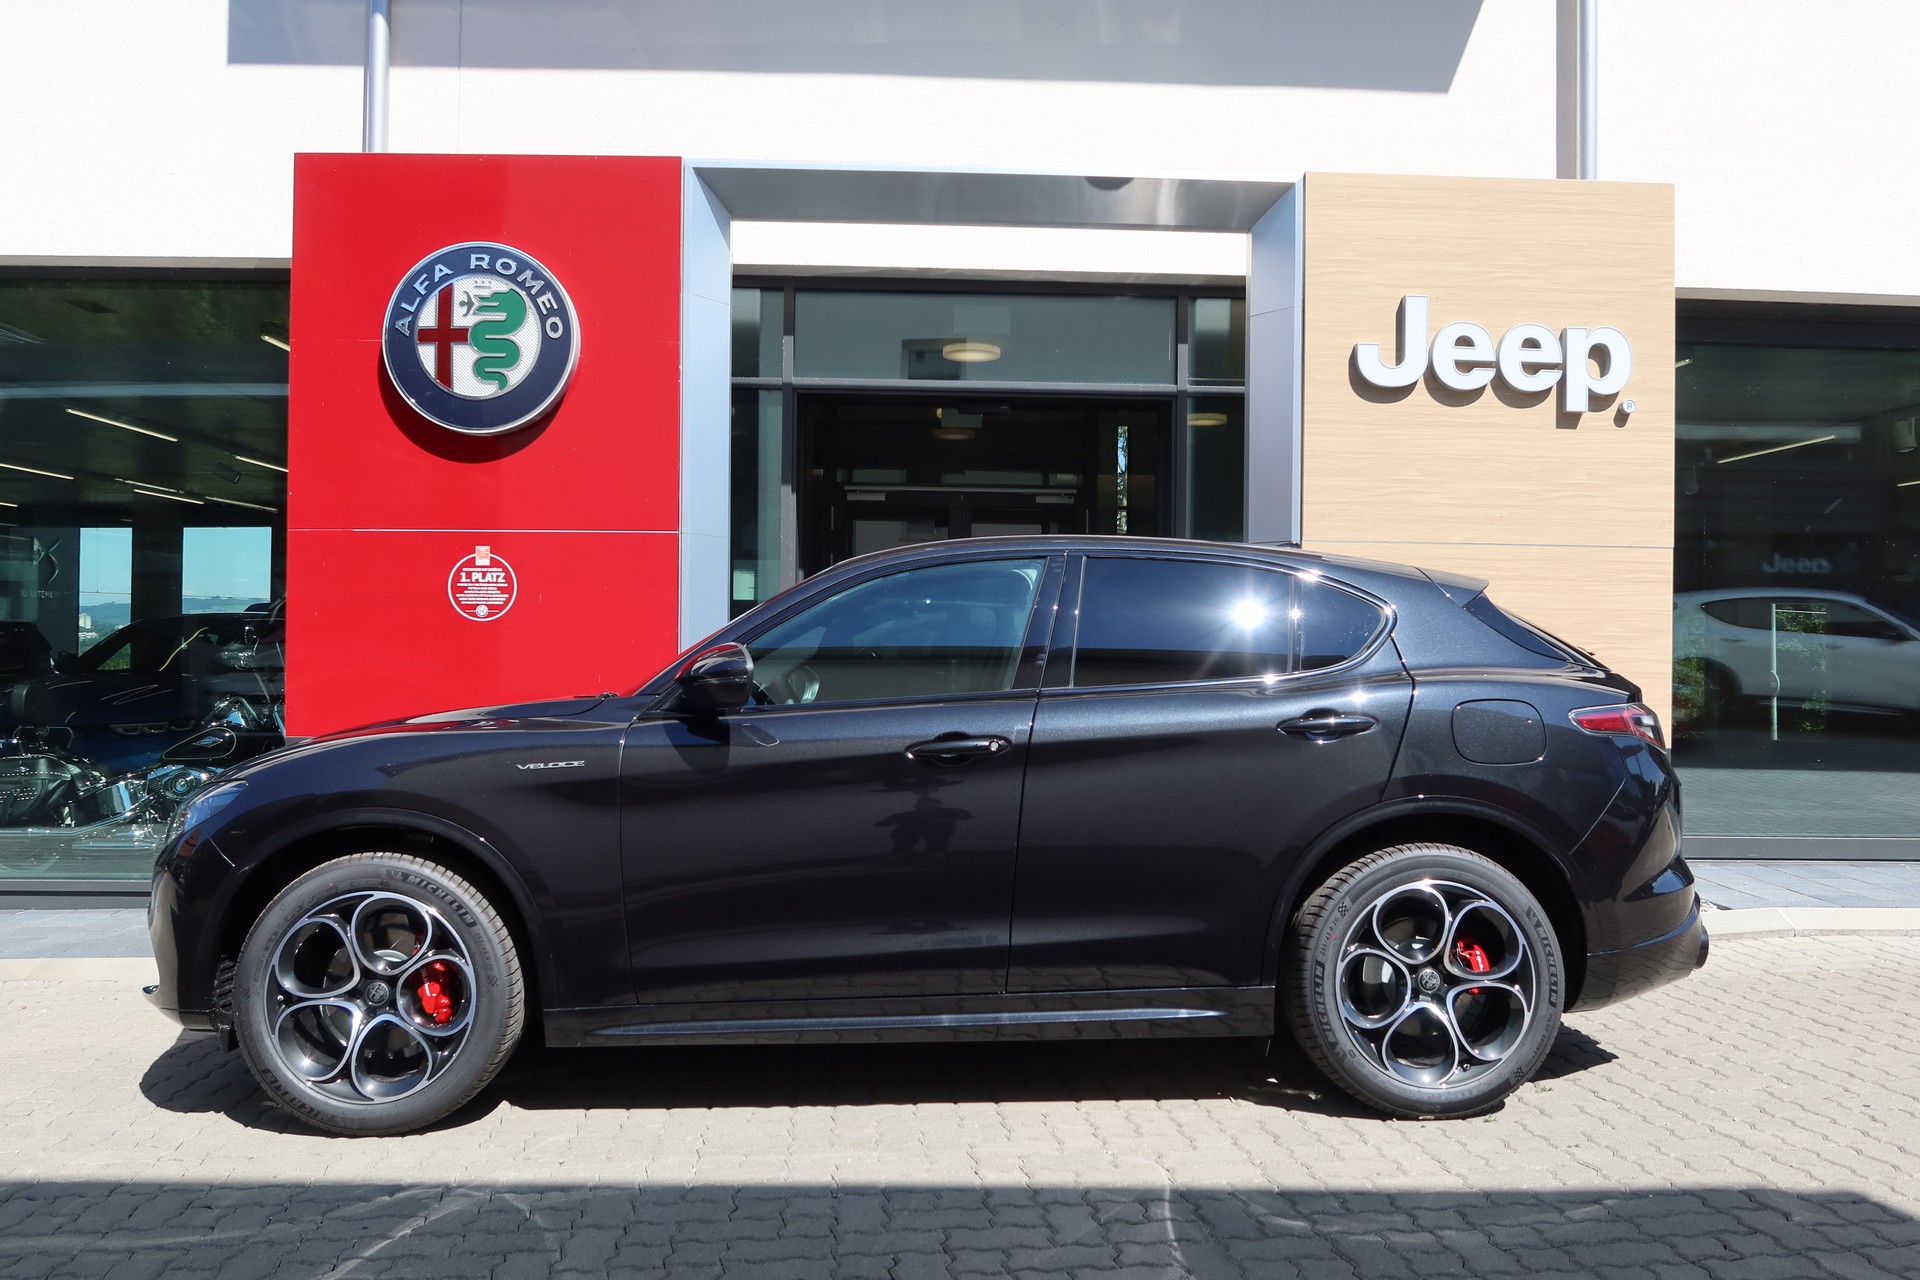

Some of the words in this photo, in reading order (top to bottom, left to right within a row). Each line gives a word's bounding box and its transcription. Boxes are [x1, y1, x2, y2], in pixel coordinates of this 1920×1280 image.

[395, 263, 453, 336] ALFA
[470, 254, 563, 339] ROMEO
[1356, 294, 1632, 412] Jeep
[460, 572, 470, 582] 1.
[472, 572, 506, 582] PLATZ
[516, 760, 585, 770] VELOCE
[407, 875, 477, 926] MICHELIN
[1314, 965, 1336, 1043] MICHELIN
[1537, 927, 1558, 1005] MICHELIN
